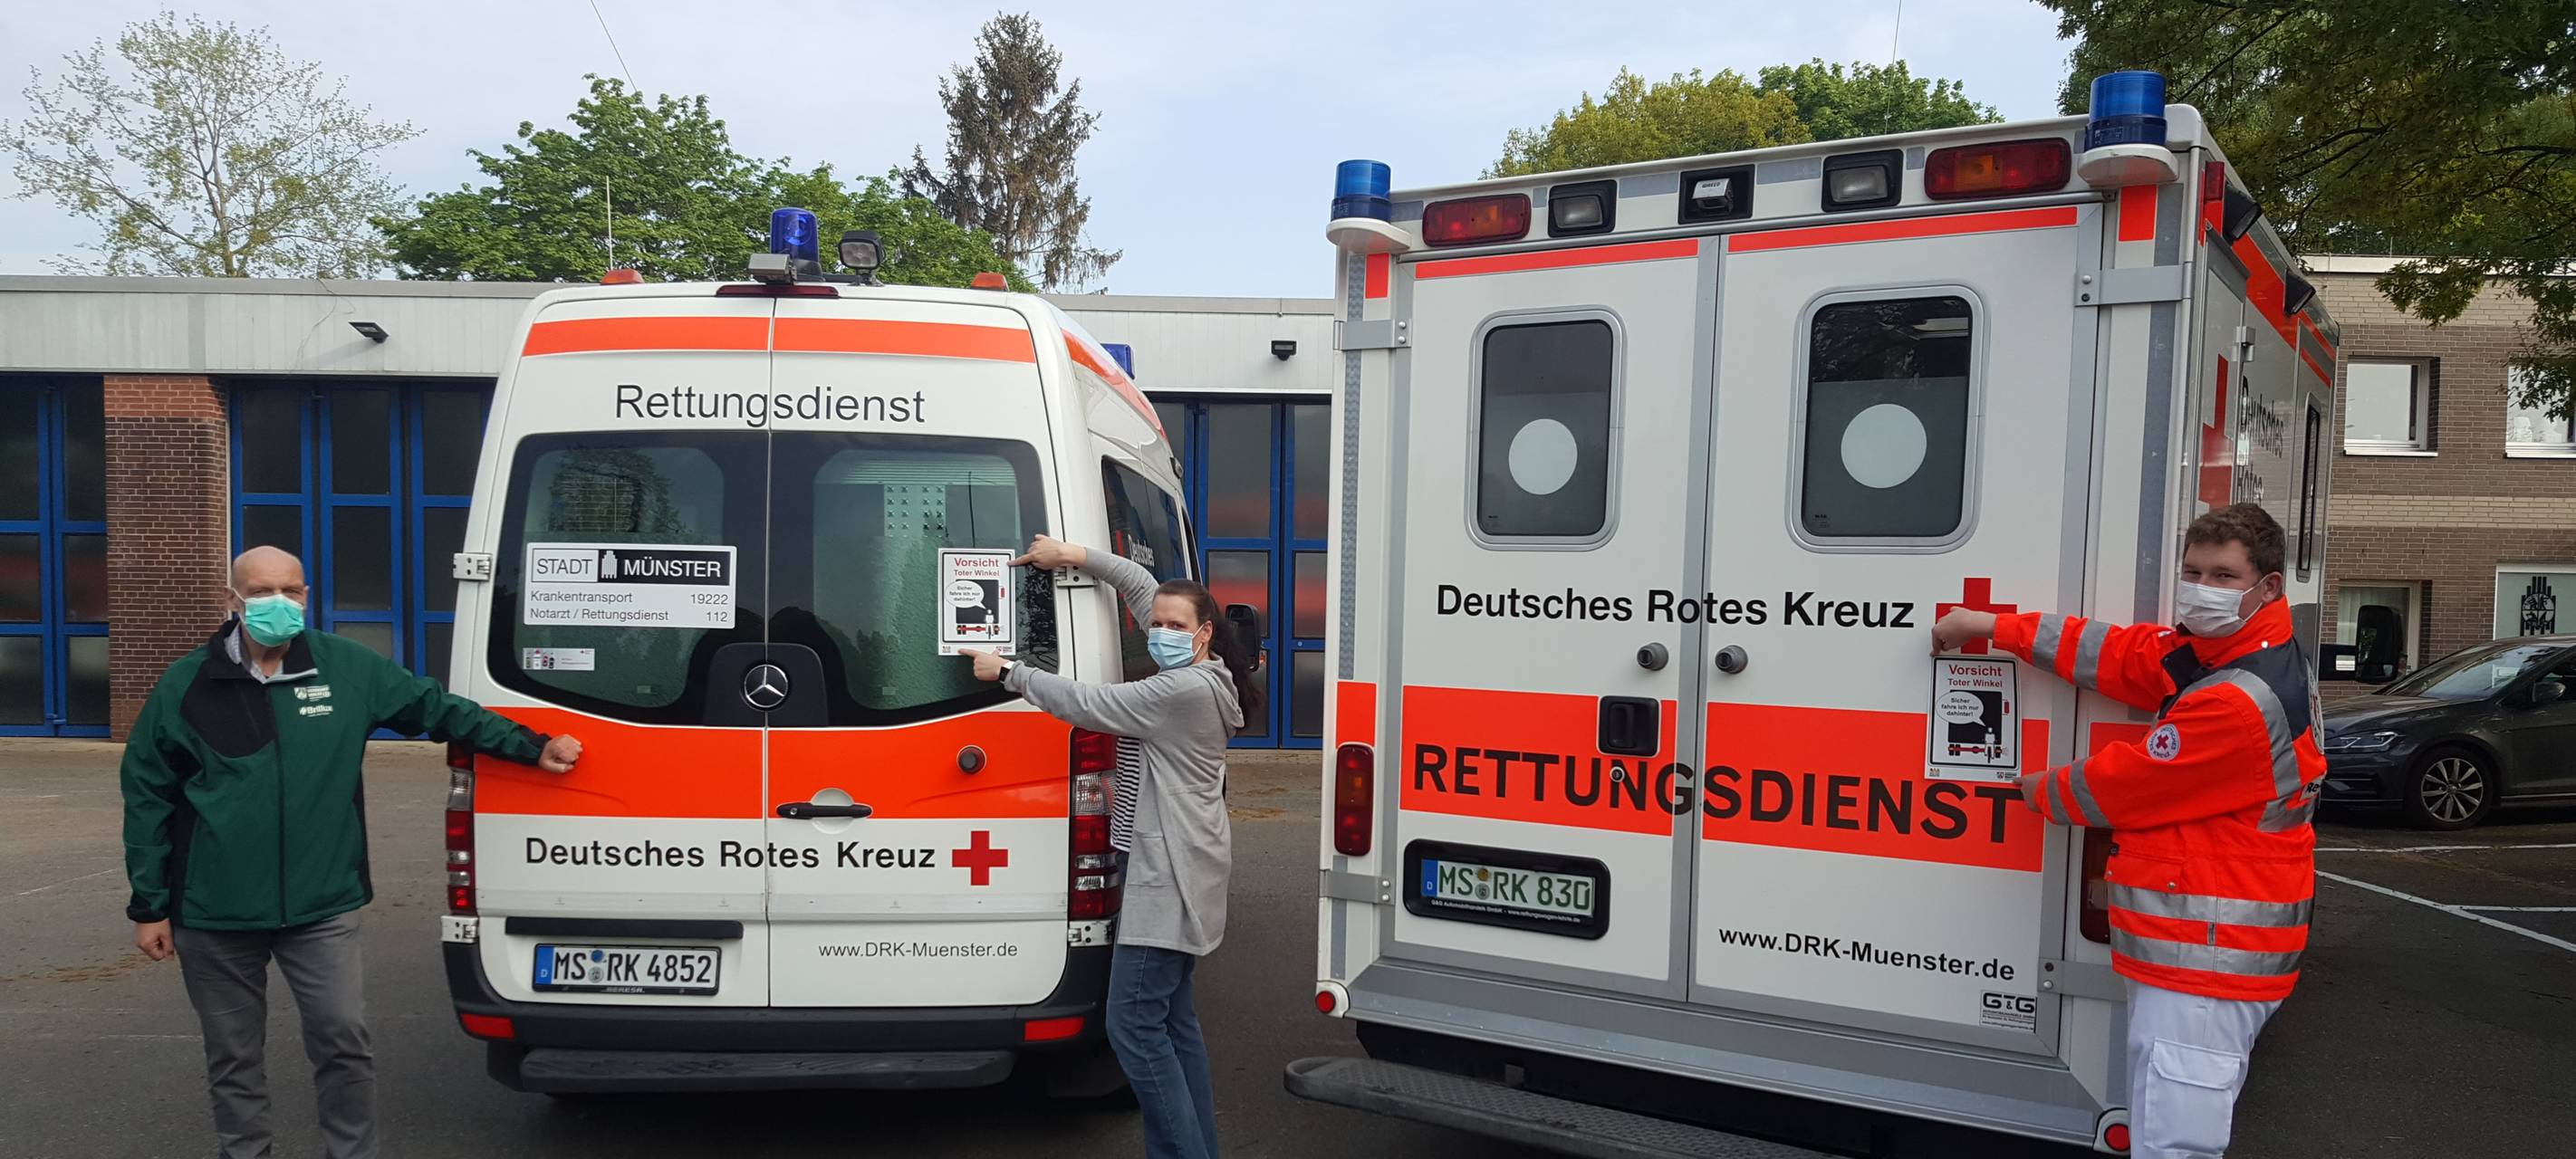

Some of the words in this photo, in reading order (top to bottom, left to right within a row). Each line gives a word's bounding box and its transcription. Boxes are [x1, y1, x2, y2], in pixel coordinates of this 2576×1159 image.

[616, 384, 926, 428] Rettungsdienst
[536, 558, 592, 575] STADT
[623, 556, 722, 578] MÜNSTER
[954, 557, 999, 568] Vorsicht
[954, 569, 973, 577] Toter
[531, 590, 633, 604] Krankentransport
[690, 593, 729, 605] 19222
[1437, 583, 1633, 621] Deutsches
[1647, 589, 1768, 626] Rotes
[1783, 591, 1915, 629] Kreuz
[530, 608, 571, 619] Notarzt
[572, 608, 580, 619] /
[582, 608, 668, 622] Rettungsdienst
[706, 611, 728, 622] 112
[1948, 664, 2003, 676] Vorsicht
[1947, 678, 1971, 686] Toter
[1973, 679, 2003, 688] Winkel
[1413, 743, 2025, 844] RETTUNGSDIENST
[525, 838, 705, 868] Deutsches
[719, 840, 819, 868] Rotes
[837, 841, 936, 868] Kreuz
[1427, 881, 1433, 890] D
[1438, 865, 1474, 896] MS
[1494, 871, 1529, 904] RK
[1537, 876, 1591, 910] 830
[818, 942, 1018, 957] www.DRK-Muenster.de
[1718, 928, 2015, 981] www.DRK-Muenster.de
[540, 969, 548, 978] D
[553, 952, 587, 981] MS
[606, 953, 641, 982] RK
[647, 953, 712, 983] 4852
